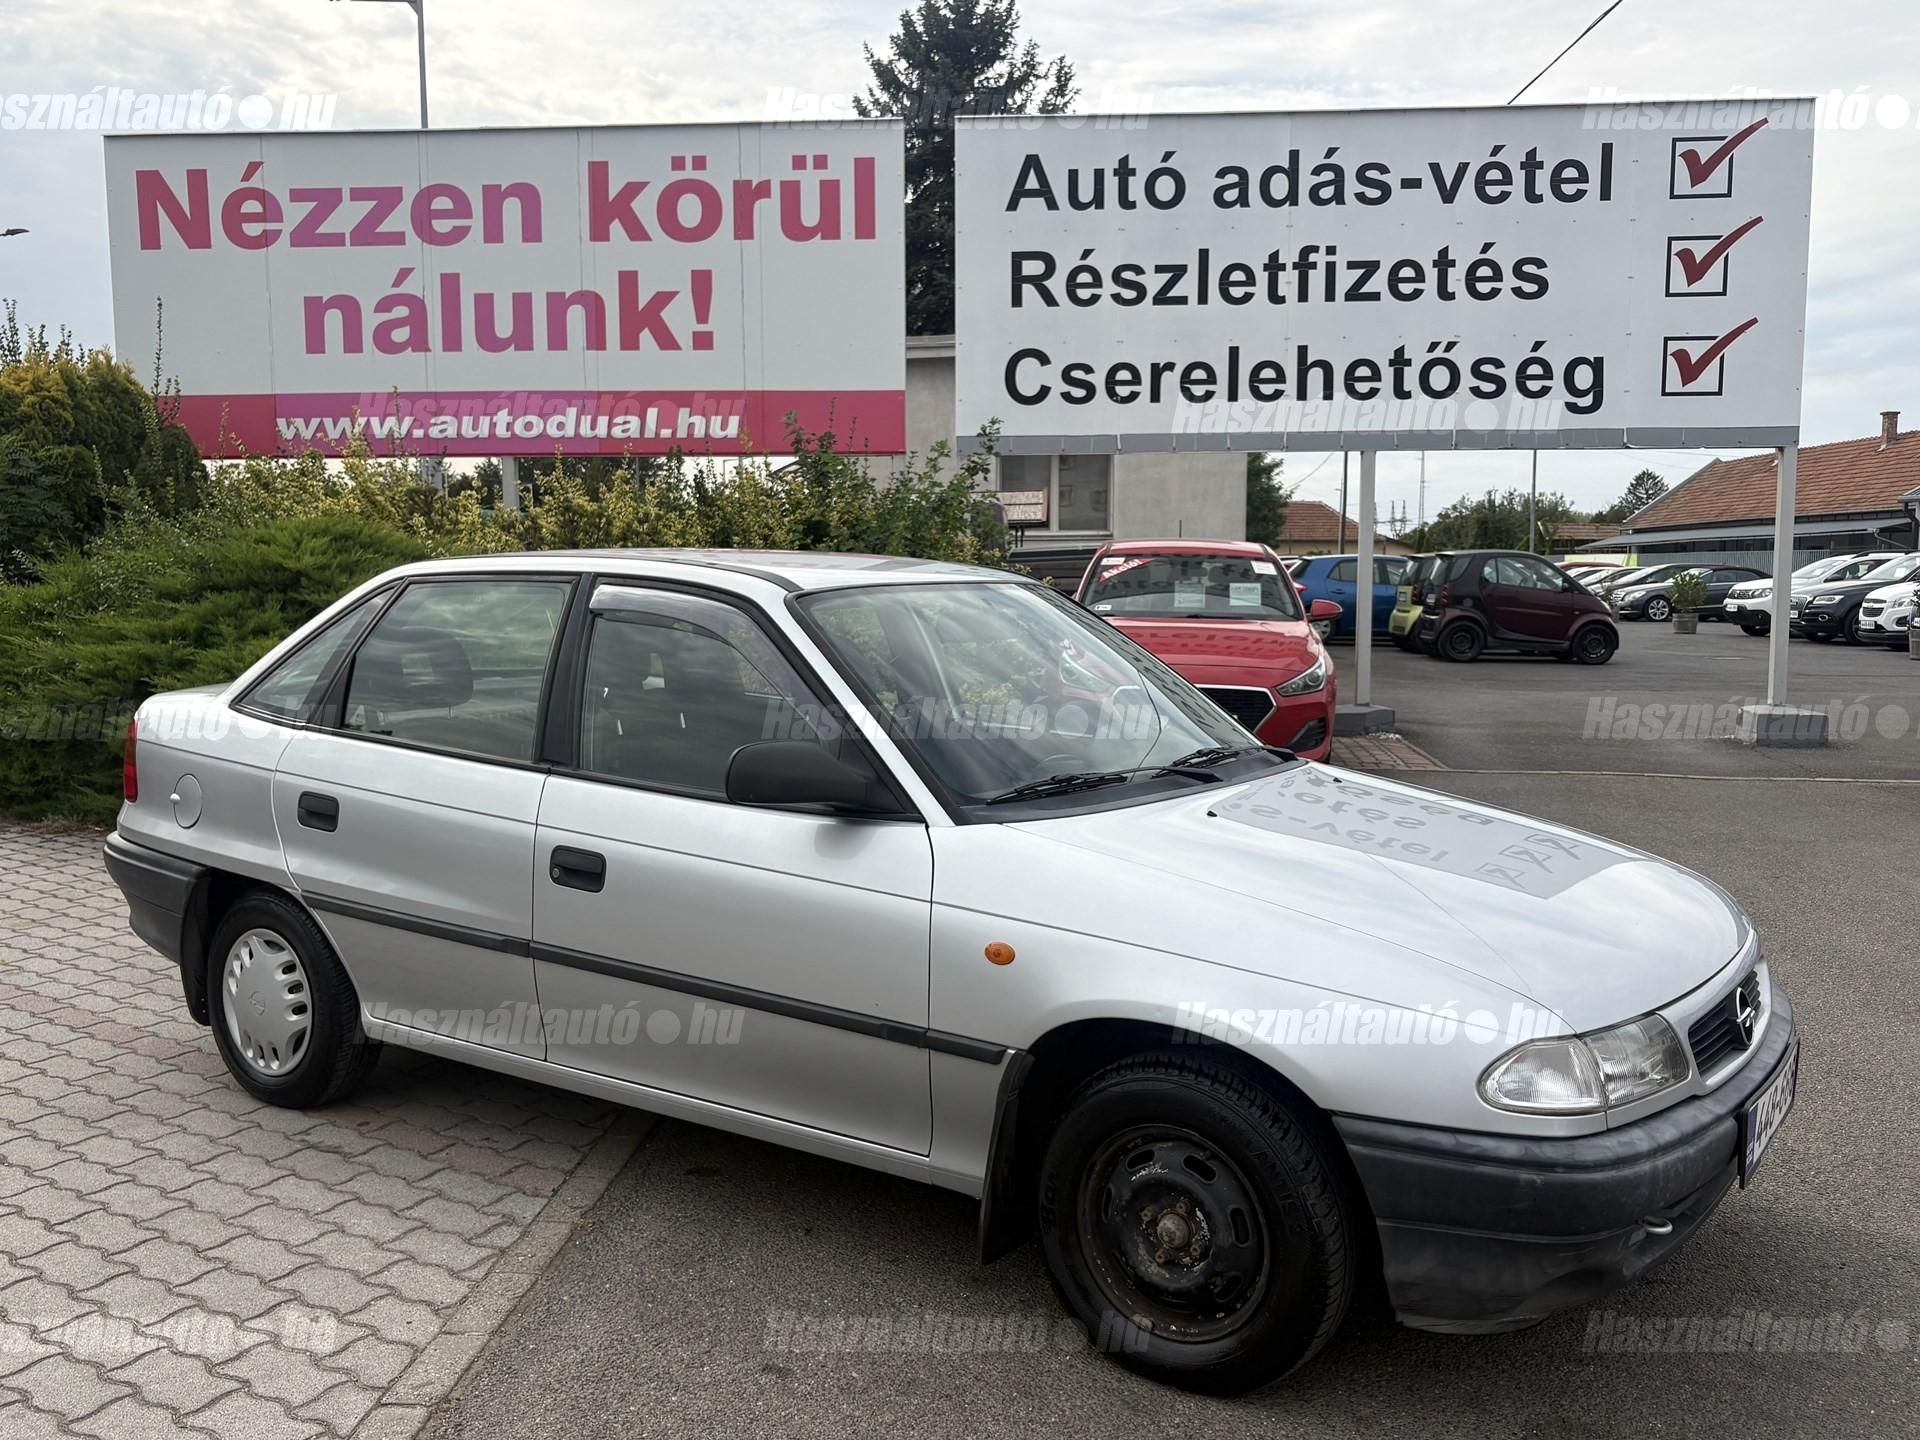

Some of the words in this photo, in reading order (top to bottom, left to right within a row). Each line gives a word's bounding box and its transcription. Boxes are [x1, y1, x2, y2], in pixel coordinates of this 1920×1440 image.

[135, 160, 543, 251] Nézzen
[588, 154, 877, 243] körül
[1005, 150, 1187, 213] Autó
[1212, 141, 1614, 208] adás-vétel
[303, 267, 714, 356] nálunk!
[1009, 241, 1550, 309] Részletfizetés
[1003, 339, 1606, 415] Cserelehetőség
[275, 406, 740, 442] www.autodual.hu
